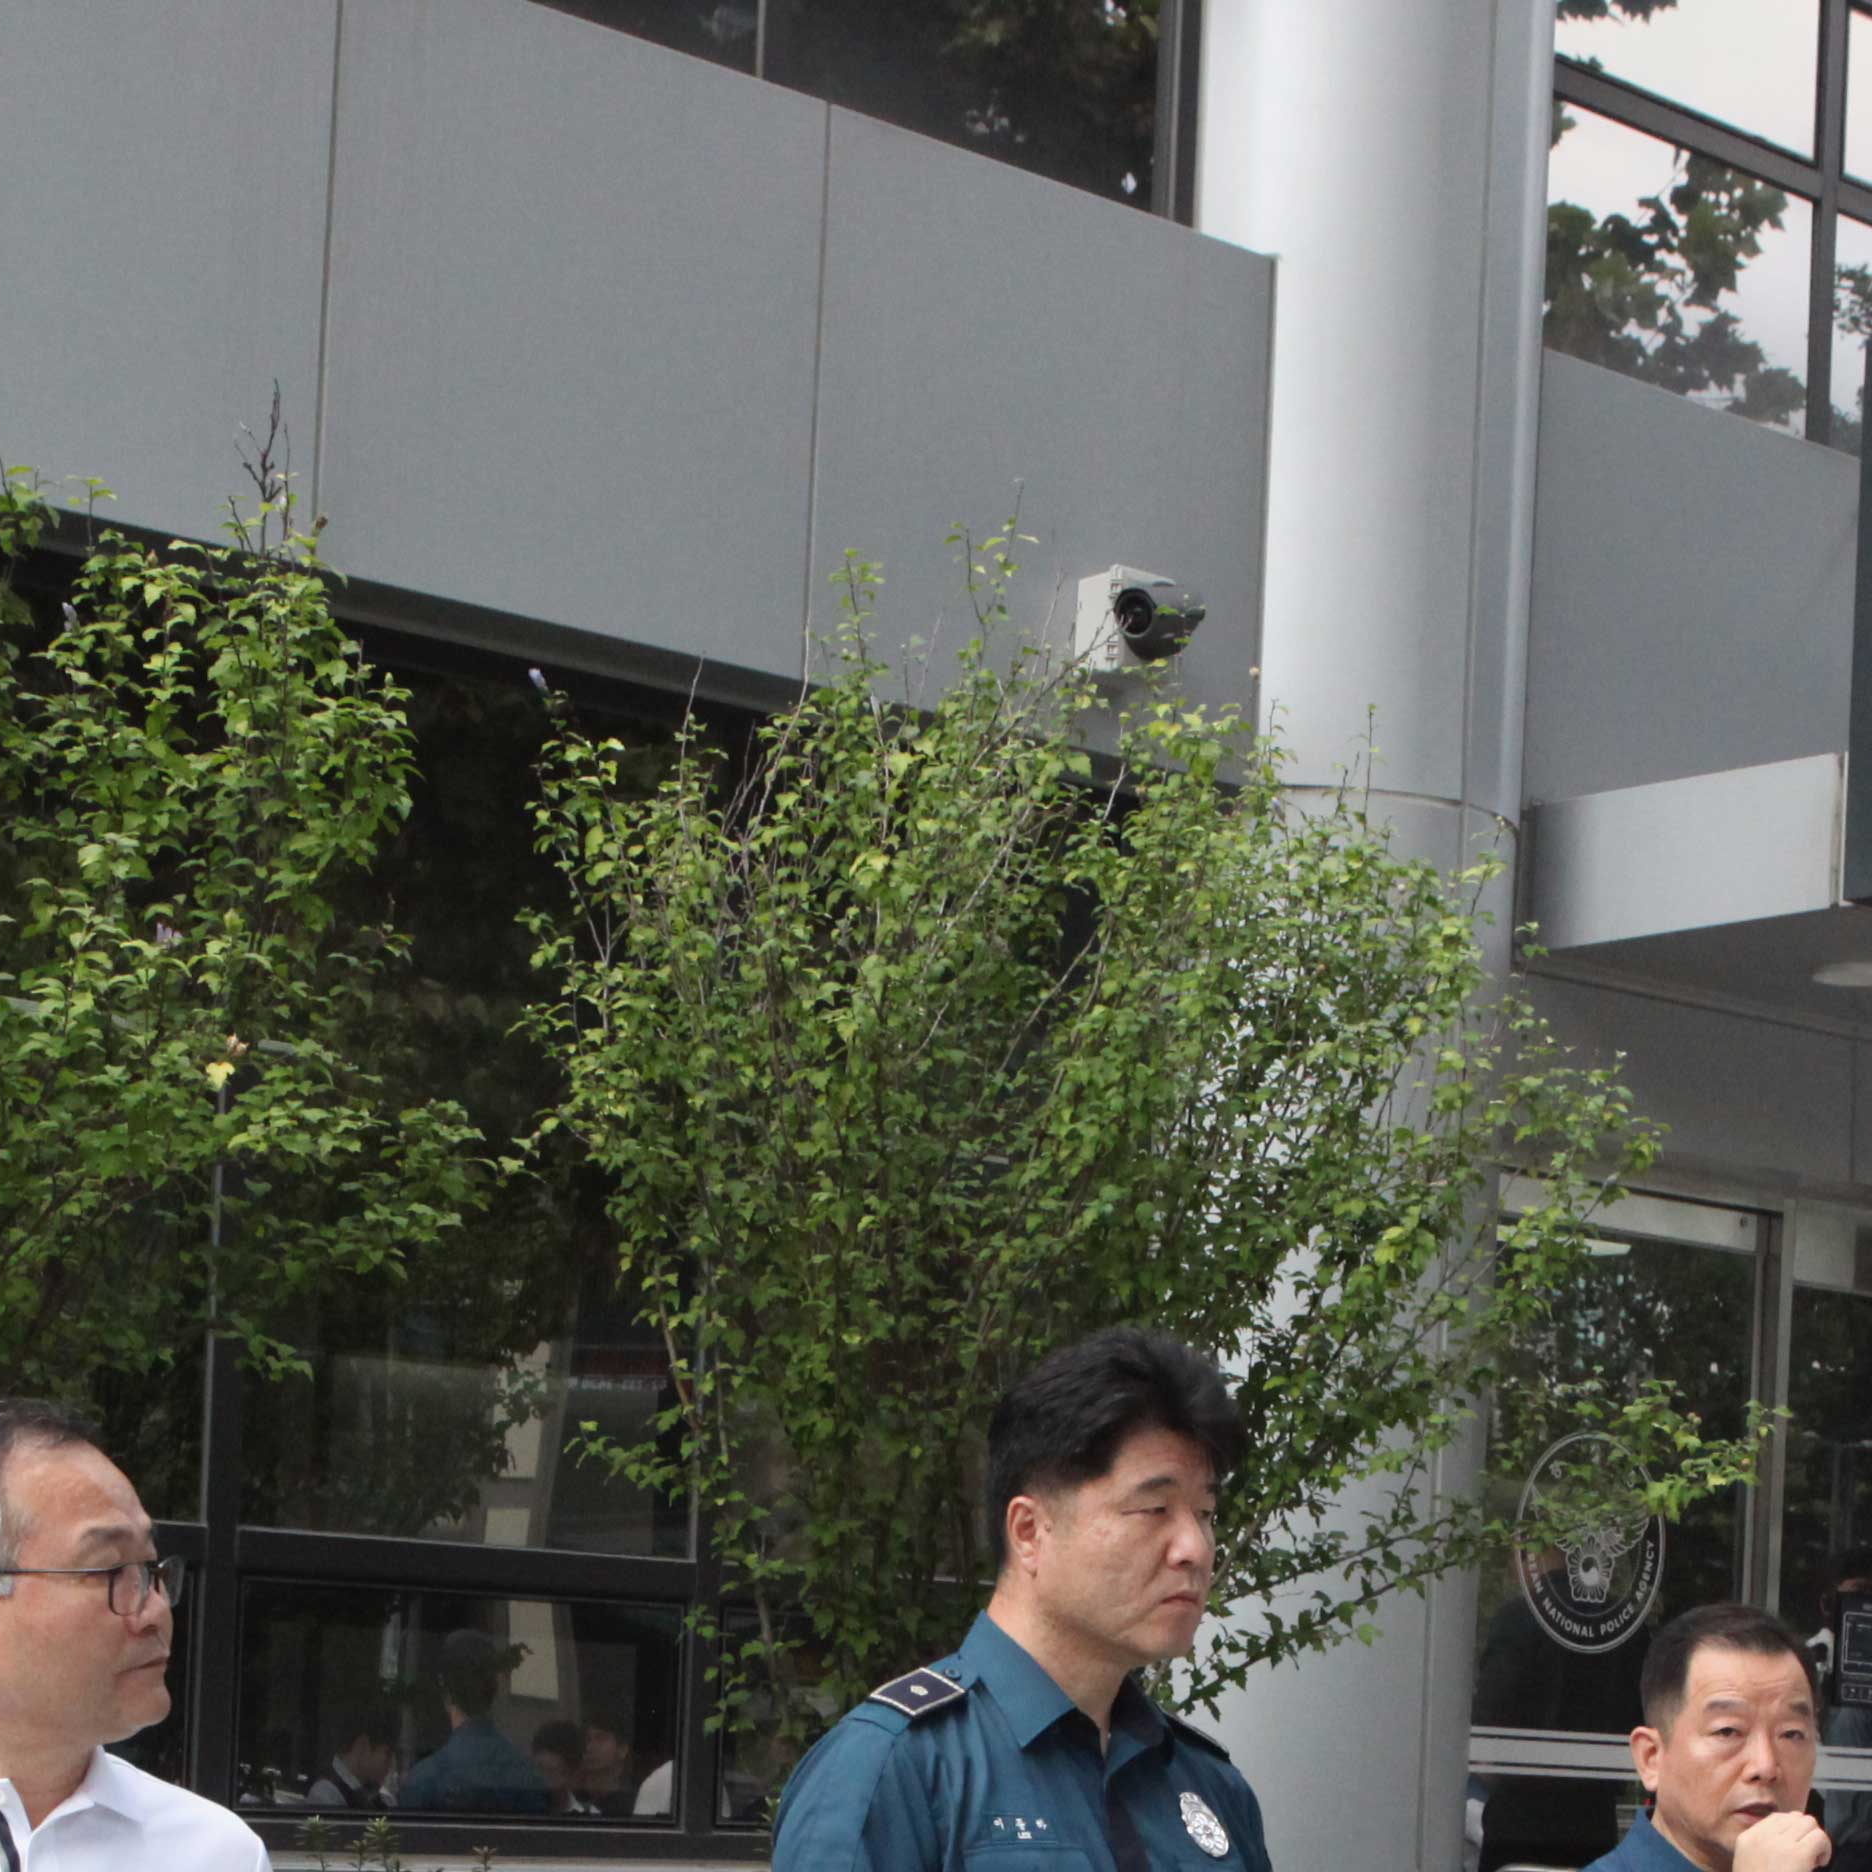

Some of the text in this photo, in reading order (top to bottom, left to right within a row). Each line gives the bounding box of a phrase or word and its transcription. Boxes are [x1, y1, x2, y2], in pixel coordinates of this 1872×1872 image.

[1541, 1596, 1595, 1638] NATIONAL
[1599, 1601, 1636, 1637] POLICE
[1634, 1539, 1656, 1604] AGENCY
